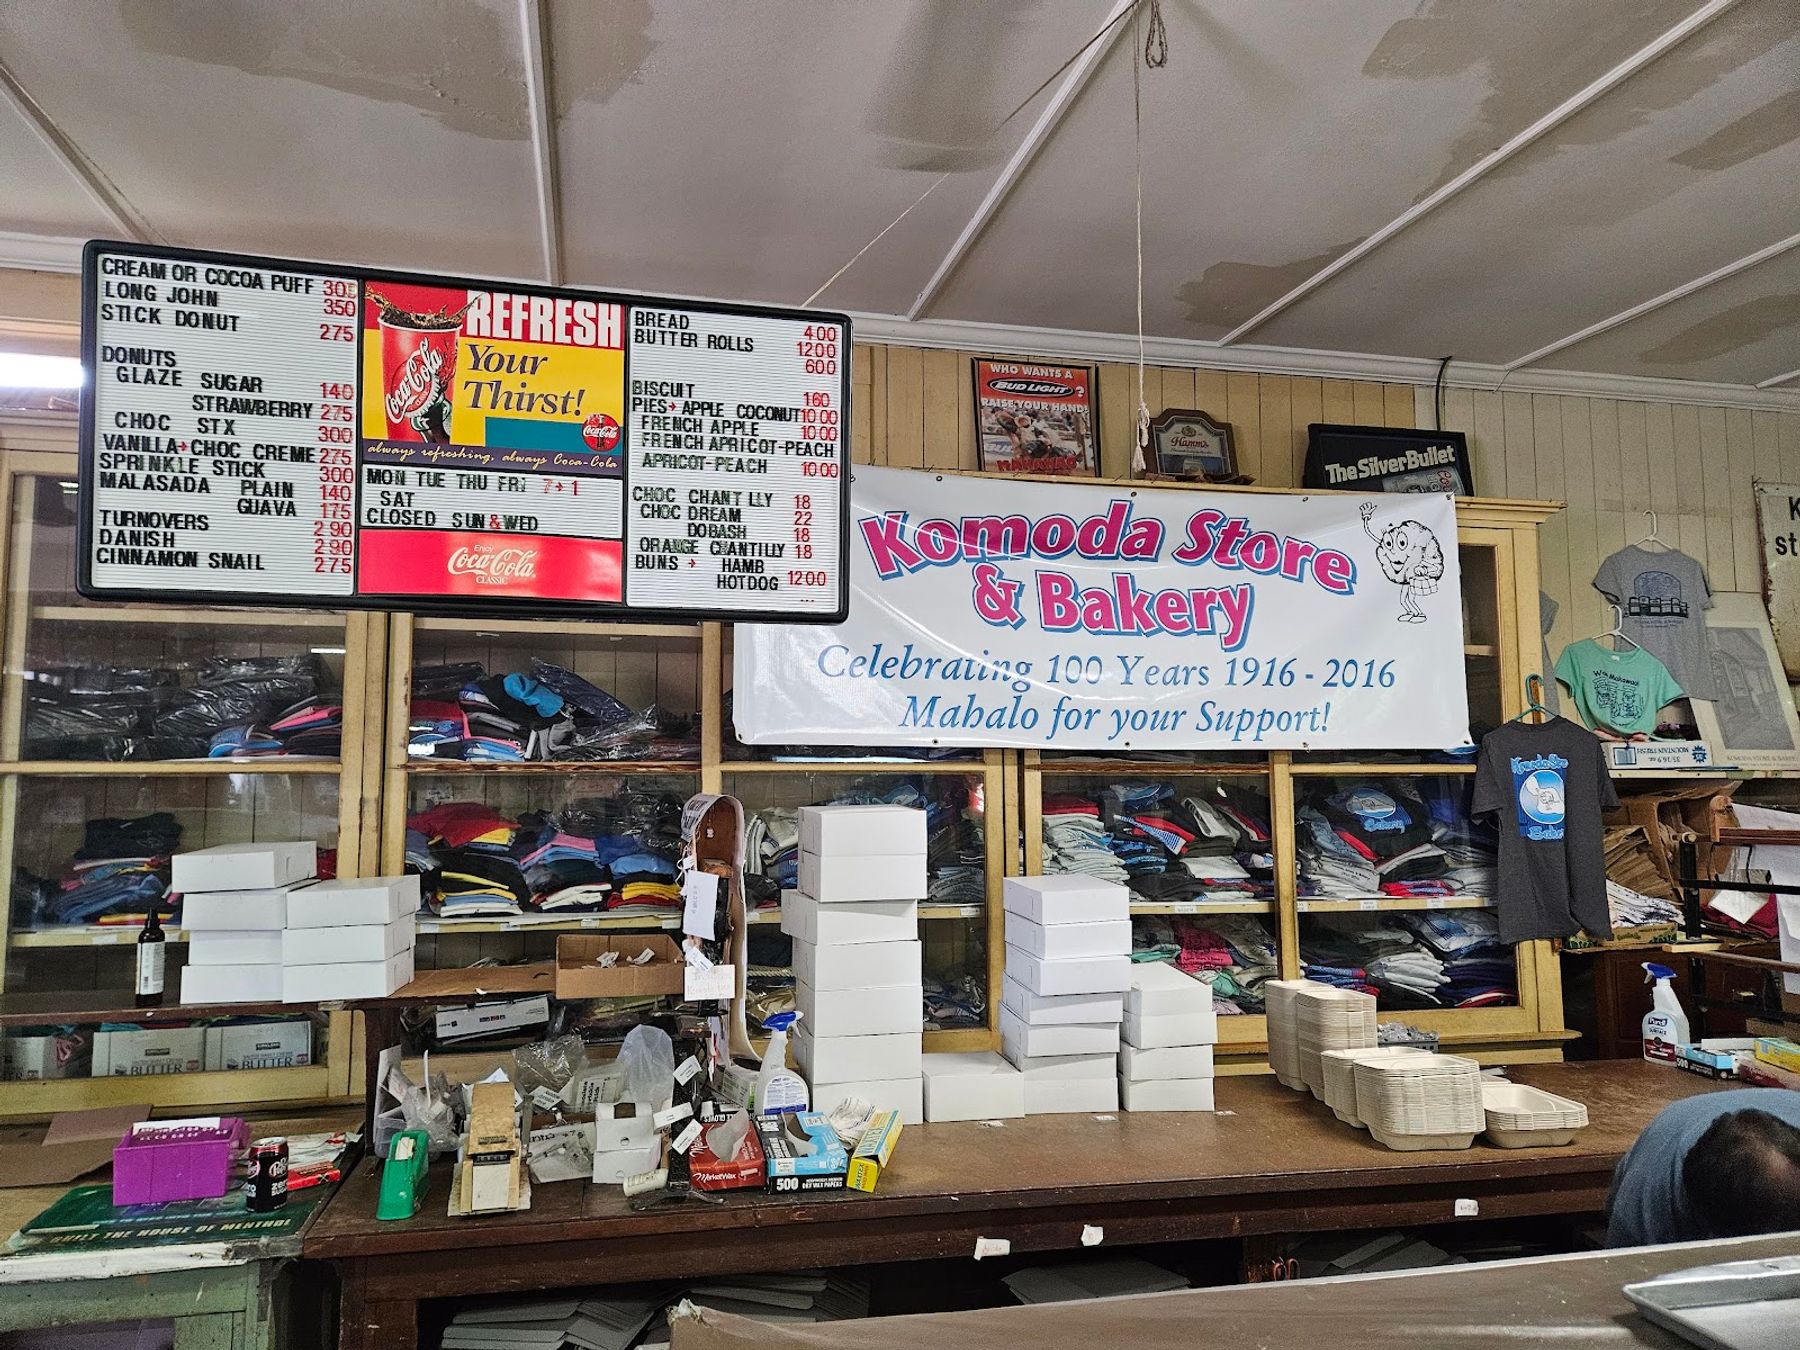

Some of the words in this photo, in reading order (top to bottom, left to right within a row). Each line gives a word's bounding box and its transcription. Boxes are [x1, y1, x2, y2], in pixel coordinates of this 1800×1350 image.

[102, 258, 166, 279] CREAM
[172, 262, 196, 282] OR
[205, 268, 264, 289] COCOA
[271, 274, 314, 294] PUFF
[104, 282, 157, 302] LONG
[166, 287, 218, 307] JOHN
[322, 299, 356, 317] 350
[101, 304, 161, 325] STICK
[175, 310, 240, 332] DONUT
[319, 324, 354, 342] 275
[466, 290, 621, 348] REFRESH
[635, 311, 689, 330] BREAD
[803, 326, 836, 342] 400
[634, 329, 697, 347] BUTTER
[708, 334, 754, 352] ROLLS
[796, 342, 836, 358] 1200
[102, 346, 176, 367] DONUTS
[466, 343, 548, 376] Your
[805, 359, 836, 375] 600
[116, 366, 182, 387] GLAZE
[200, 372, 262, 392] SUGAR
[319, 382, 354, 400] 140
[990, 363, 1018, 374] WHO
[1022, 366, 1062, 377] WANTS
[1064, 370, 1073, 379] A
[464, 379, 585, 416] Thirst!
[632, 380, 695, 398] BISCUIT
[803, 392, 830, 407] 160
[995, 381, 1026, 391] BUD
[1028, 382, 1070, 394] LIGHT
[192, 395, 313, 419] STRAWBERRY
[321, 404, 352, 421] 275
[632, 397, 668, 414] PIES
[682, 400, 724, 417] APPLE
[737, 404, 800, 422] COCONUT
[981, 397, 1014, 408] RAISE
[1018, 400, 1050, 410] YOUR
[114, 411, 171, 431] CHOC
[197, 418, 235, 435] STX
[318, 426, 352, 443] 300
[641, 415, 702, 433] FRENCH
[710, 420, 759, 436] APPLE
[103, 434, 178, 454] VANILLA
[190, 441, 241, 459] CHOC
[253, 444, 315, 463] CREME
[319, 448, 352, 465] 275
[368, 444, 415, 463] always
[502, 452, 547, 470] always
[553, 454, 618, 468] Coca-Cola
[642, 432, 703, 450] FRENCH
[708, 436, 834, 458] APRICOT-PEACH
[99, 452, 199, 474] SPRINKLE
[212, 459, 265, 478] STICK
[319, 467, 354, 482] 300
[642, 452, 767, 473] APRICOT-PEACH
[1325, 462, 1358, 484] The
[1357, 456, 1407, 479] Silver
[1405, 445, 1456, 470] Bullet
[99, 472, 211, 494] MALASADA
[240, 479, 293, 498] PLAIN
[319, 485, 351, 501] 140
[366, 468, 405, 486] MON
[416, 471, 445, 488] TUE
[456, 474, 487, 490] THU
[498, 476, 526, 492] FRI
[237, 499, 297, 517] GUAVA
[319, 503, 351, 519] 175
[380, 490, 414, 507] SAT
[632, 486, 675, 502] CHOC
[794, 495, 811, 509] 18
[99, 509, 209, 531] TURNOVERS
[366, 508, 436, 526] CLOSED
[452, 513, 484, 529] SUN
[489, 514, 500, 530] &
[502, 515, 538, 531] WED
[640, 504, 680, 520] CHOC
[688, 506, 741, 523] DREAM
[794, 511, 812, 526] 22
[99, 529, 175, 548] DANISH
[688, 523, 746, 539] DOBASH
[794, 528, 810, 542] 18
[96, 548, 198, 569] CINNAMON
[208, 552, 265, 571] SNAIL
[474, 544, 493, 554] Enjoy
[640, 537, 698, 554] ORANGE
[710, 540, 785, 558] CHANTILLY
[794, 545, 812, 559] 18
[858, 499, 1163, 582] Komoda
[1172, 506, 1356, 596] Store
[448, 546, 538, 578] Coca-Cola
[635, 554, 678, 570] BUNS
[722, 558, 764, 574] HAMB
[476, 575, 508, 585] CLASSIC
[717, 574, 779, 591] HOTDOG
[787, 570, 826, 586] 1200
[971, 560, 1026, 631] &
[1034, 568, 1255, 654] Bakery
[817, 644, 1033, 693] Celebrating
[1046, 654, 1104, 686] 100
[1116, 654, 1210, 688] Years
[1224, 657, 1298, 689] 1916
[1324, 657, 1396, 690] 2016
[898, 693, 1039, 730] Mahalo
[1045, 699, 1101, 740] for
[1109, 705, 1188, 743] your
[1195, 699, 1333, 743] Support!
[776, 1177, 798, 1191] 500
[102, 1230, 132, 1240] THE
[136, 1226, 189, 1238] HOUSE
[195, 1224, 214, 1234] OF
[220, 1218, 292, 1232] MENTHOL
